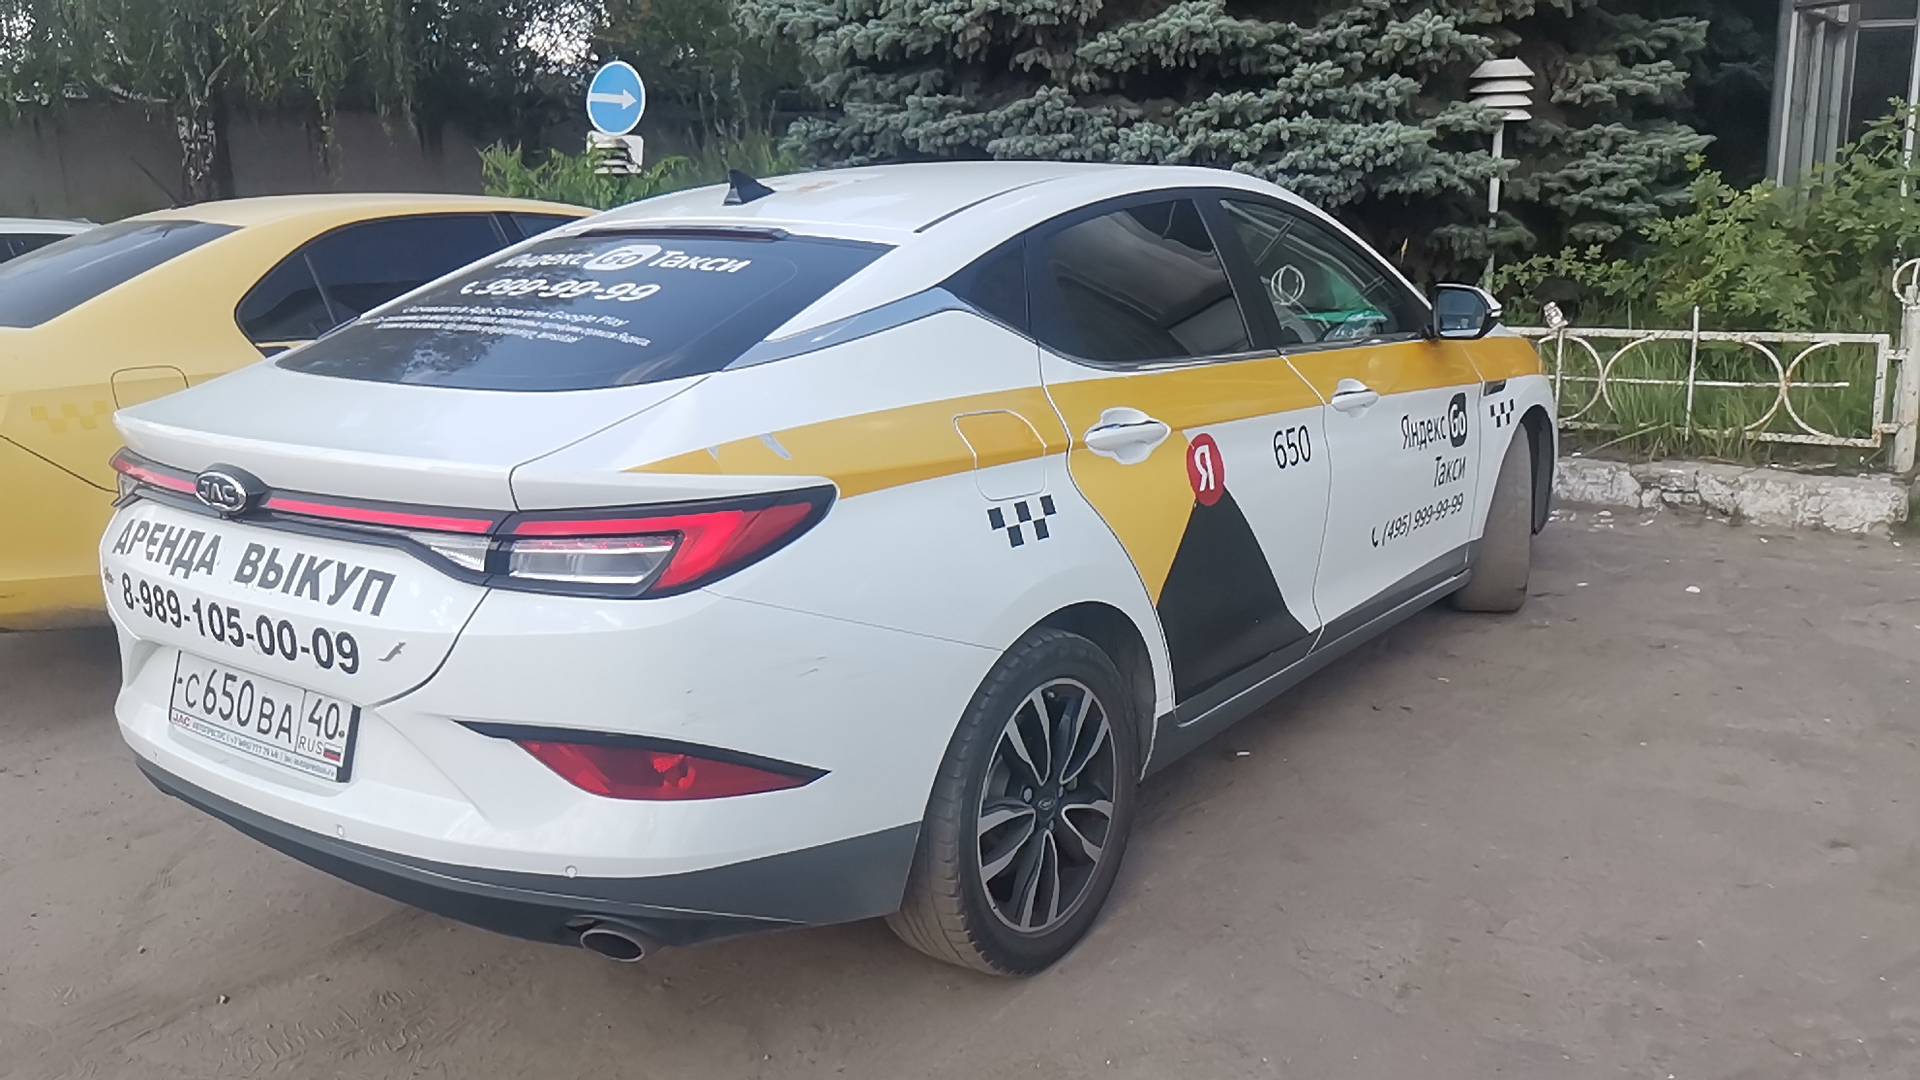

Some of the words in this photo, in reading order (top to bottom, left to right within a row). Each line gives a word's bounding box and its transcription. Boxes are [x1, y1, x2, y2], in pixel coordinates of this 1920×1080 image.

[649, 250, 751, 273] Такси
[475, 278, 661, 301] 999-99-99
[1273, 424, 1312, 470] 650
[1402, 414, 1447, 450] Яндекс
[1449, 401, 1469, 440] Go
[1194, 444, 1215, 492] Я
[1433, 456, 1466, 488] Такси
[200, 480, 236, 503] JAC
[1381, 513, 1412, 547] (495)
[1414, 492, 1464, 530] 999-99-99
[112, 518, 222, 579] АРЕНДА
[233, 542, 397, 617] ВЫКУП
[120, 572, 360, 675] 8-989-105-00-09
[308, 698, 341, 741] 40
[298, 735, 324, 756] RUS
